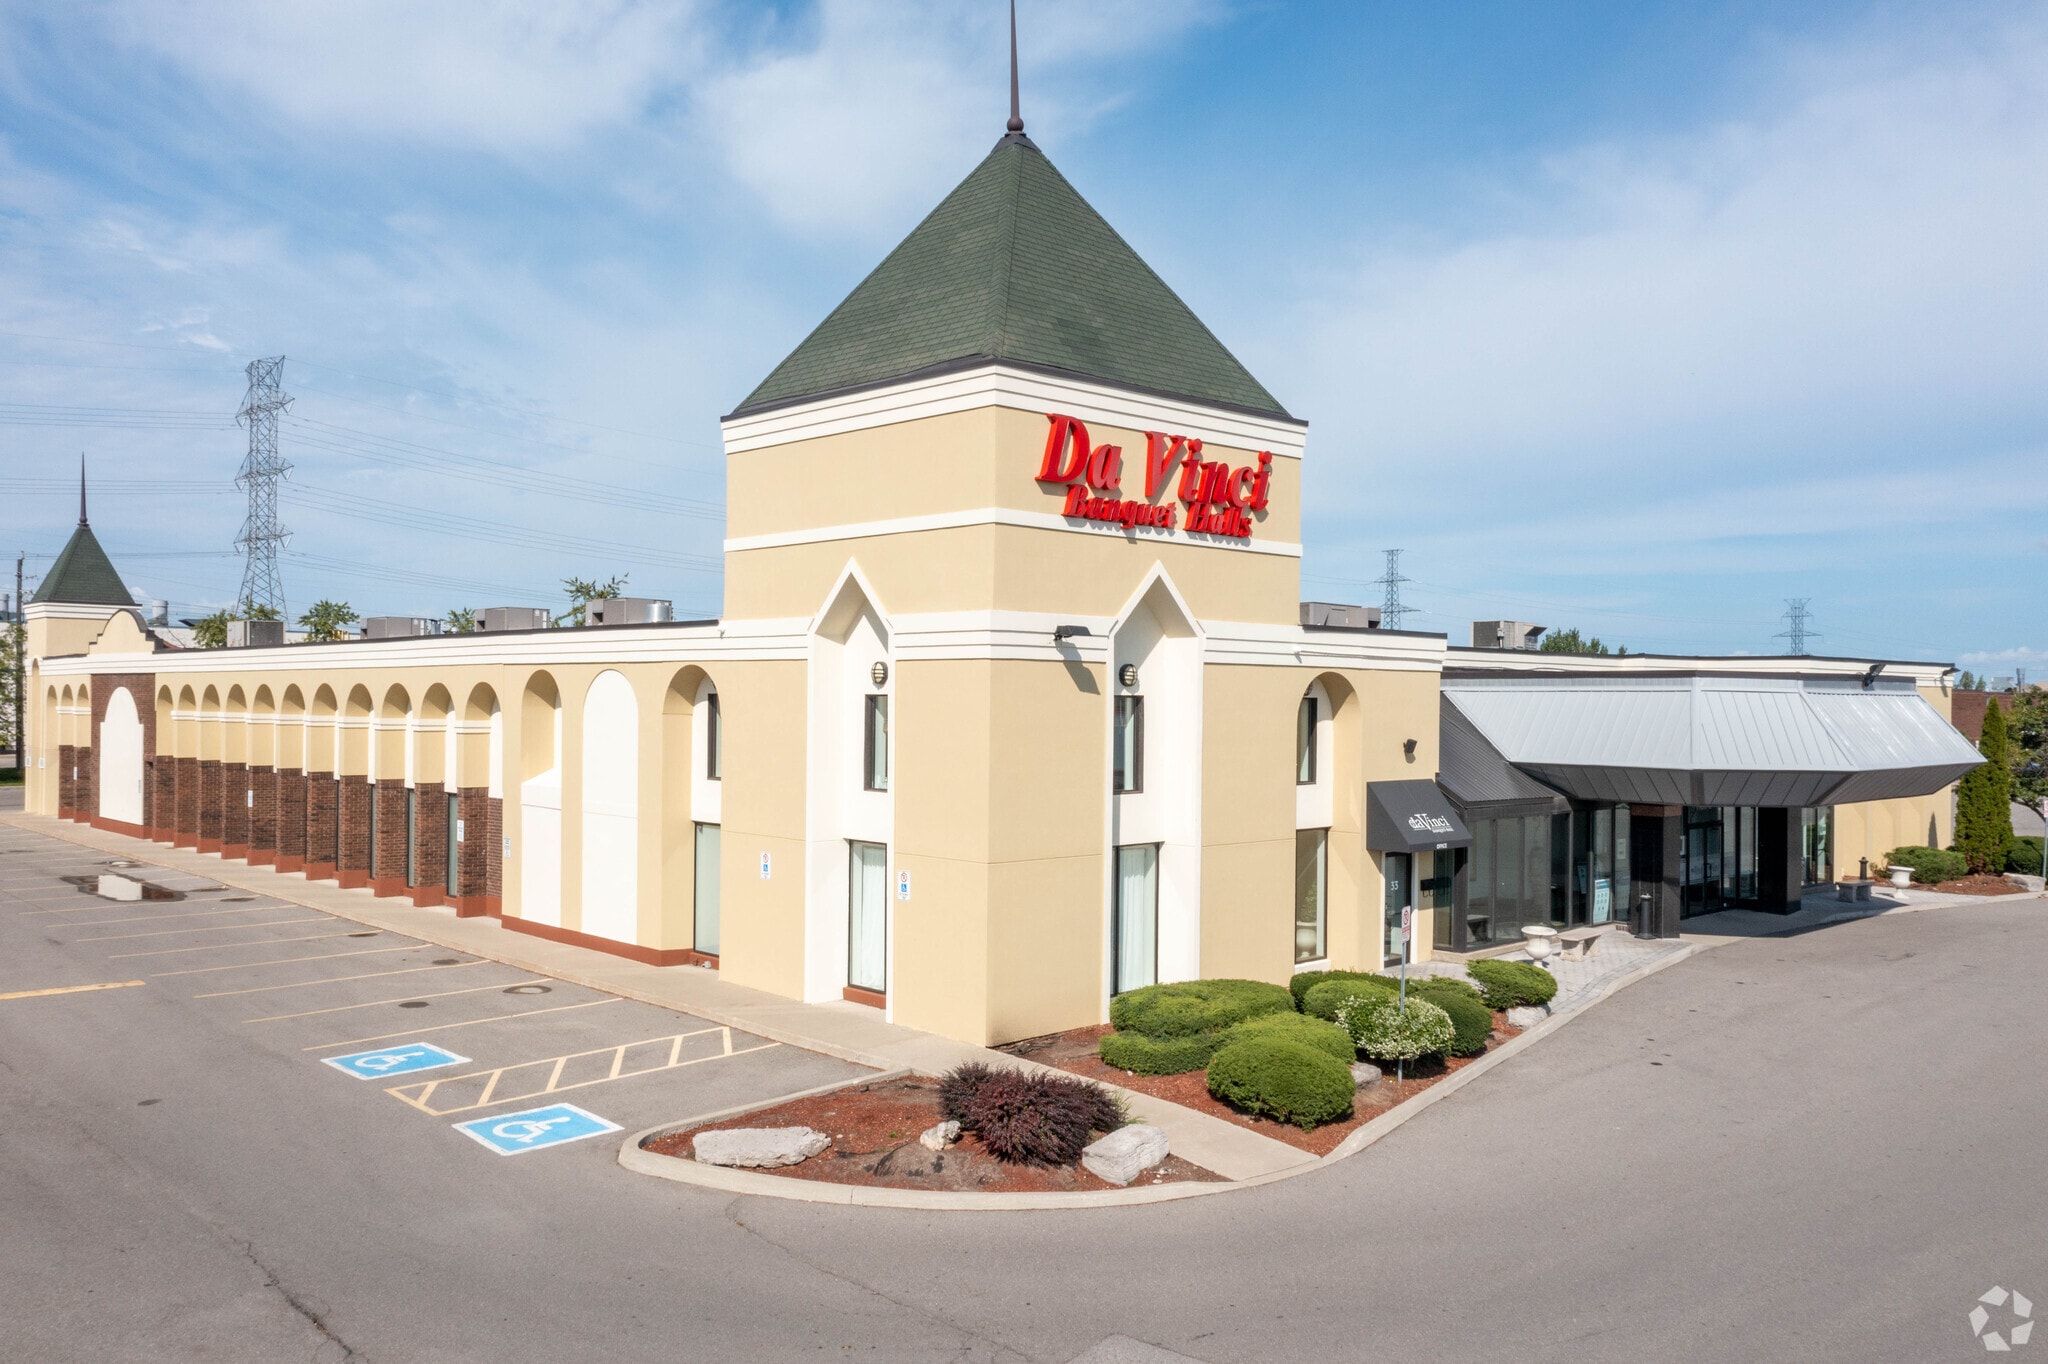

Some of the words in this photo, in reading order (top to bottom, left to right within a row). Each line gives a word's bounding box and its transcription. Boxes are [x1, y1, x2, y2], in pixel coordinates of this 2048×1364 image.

[1035, 413, 1122, 490] Da
[1145, 430, 1273, 511] Vinci
[1061, 483, 1176, 529] Banquet
[1183, 501, 1252, 538] Halls
